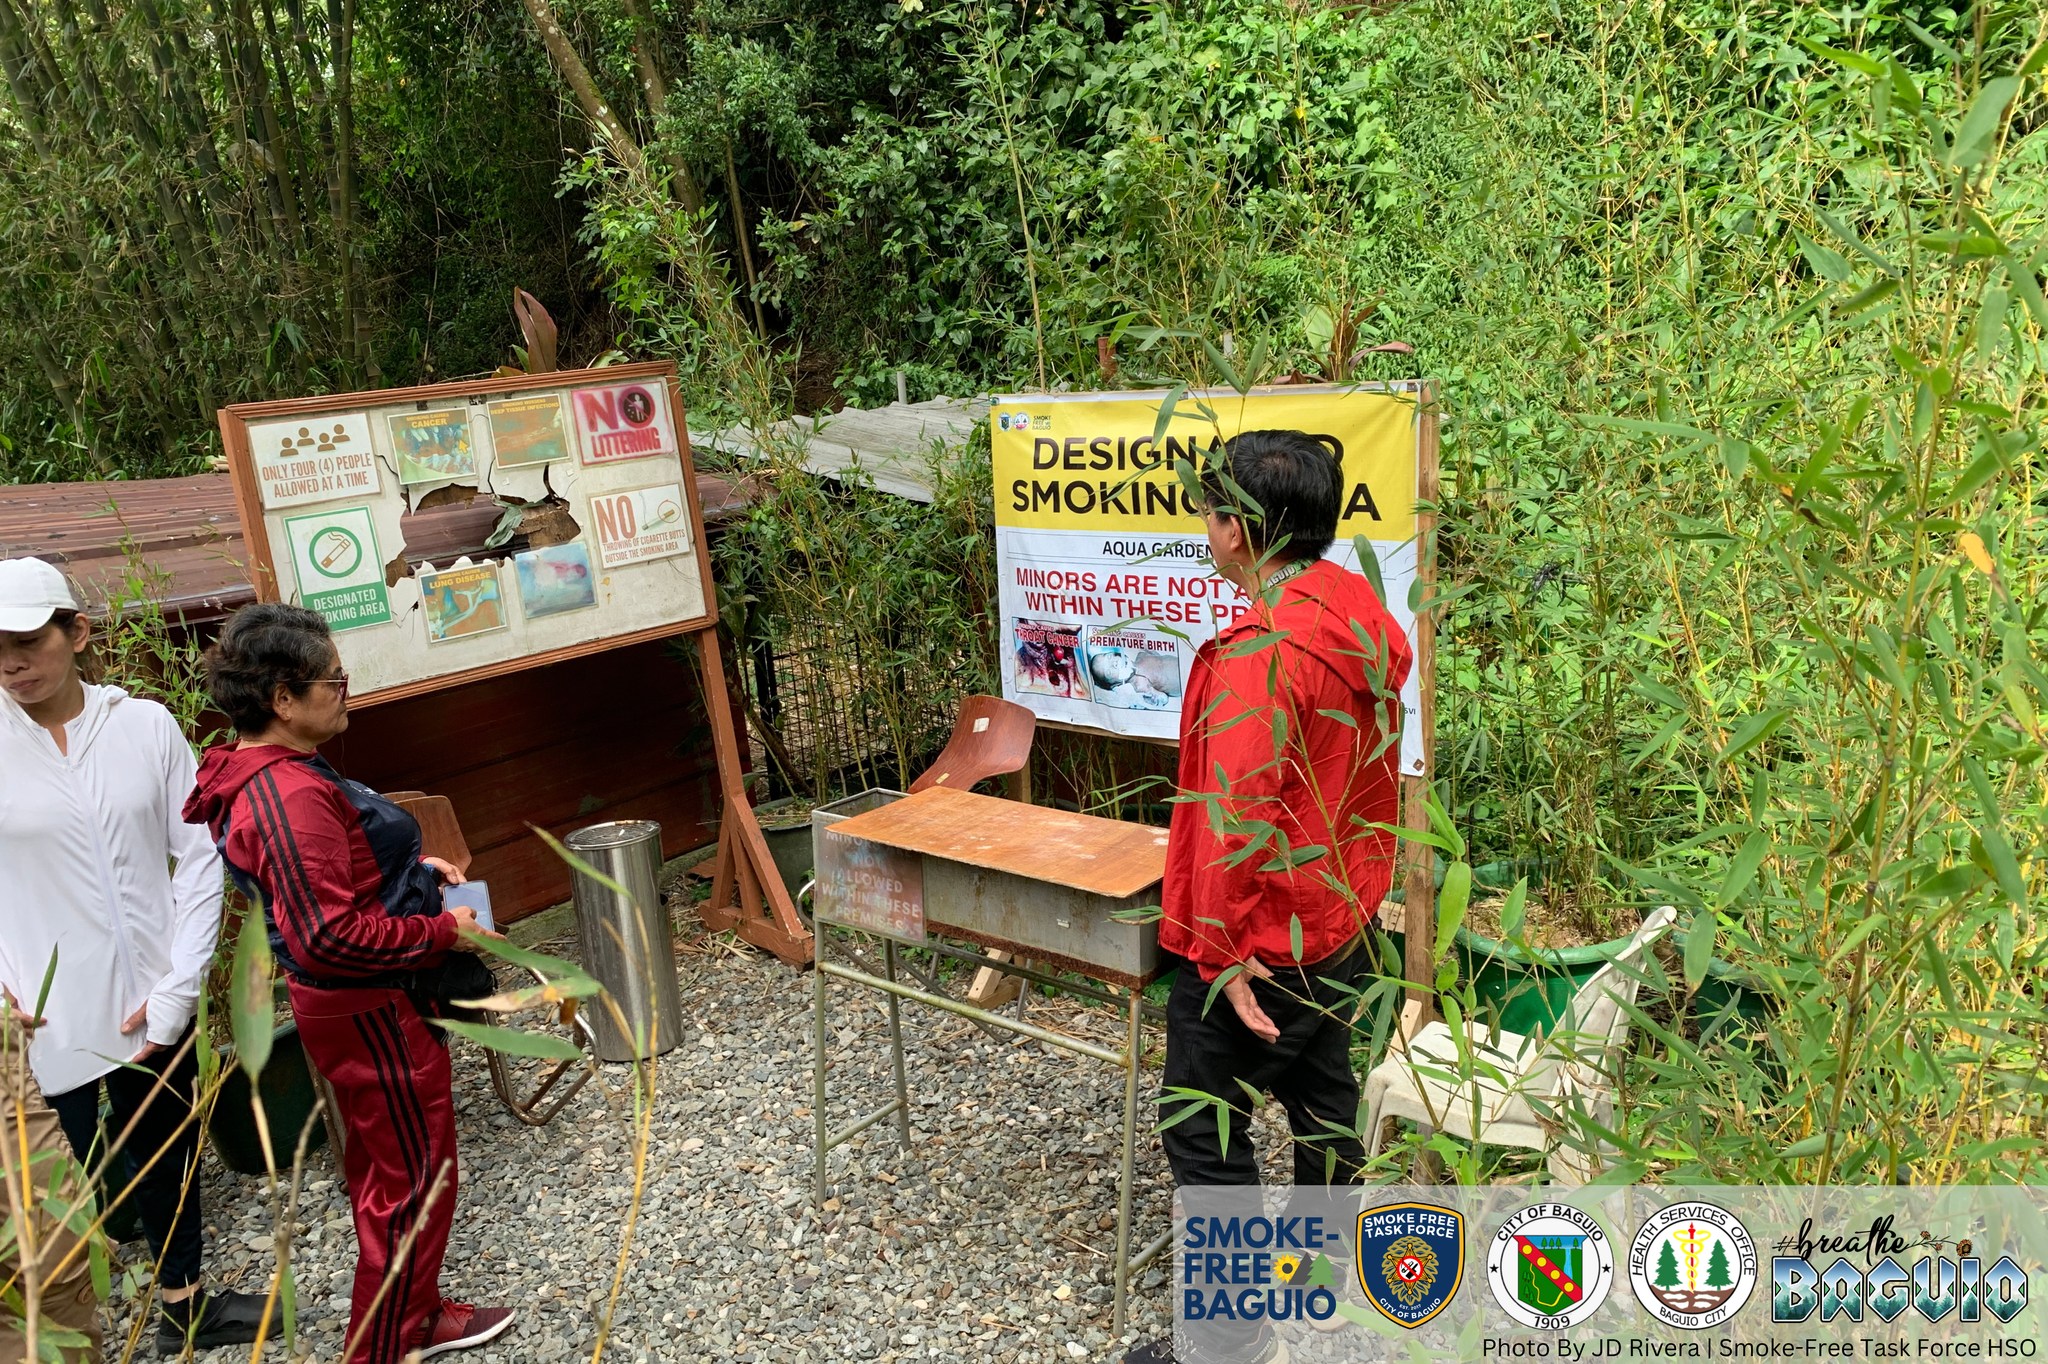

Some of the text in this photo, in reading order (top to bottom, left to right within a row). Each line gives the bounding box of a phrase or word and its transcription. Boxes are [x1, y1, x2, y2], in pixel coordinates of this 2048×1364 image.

[505, 405, 526, 413] TISSUE
[526, 402, 559, 410] INFECTIONS
[580, 385, 656, 432] NO
[411, 418, 448, 428] CANCER
[591, 427, 661, 458] LITTERING
[1033, 434, 1344, 470] DESIGND
[262, 453, 372, 481] ONLY FOUR (4) PEOPLE
[274, 471, 369, 498] ALLOWED AT A TIME
[595, 495, 637, 543] NO
[603, 529, 686, 552] THROWING OF CIGARETTE BUTTS
[605, 541, 679, 563] OUTSIDE THE SMOKING AREA
[1103, 541, 1147, 558] AQUA
[429, 571, 491, 589] LUNG DISEASE
[1016, 567, 1097, 592] MINORS
[1105, 573, 1159, 596] ARE
[1168, 576, 1225, 599] NOT
[313, 588, 377, 611] DESIGNATED
[1025, 591, 1104, 617] WITHIN
[1111, 598, 1201, 624] THESE
[321, 601, 386, 623] OKING AREA
[1014, 628, 1080, 649] THROAT CANCER
[1089, 636, 1175, 652] PREMATURE BIRTH
[1122, 631, 1146, 639] CAUSES
[821, 882, 921, 918] WITHIN THESE
